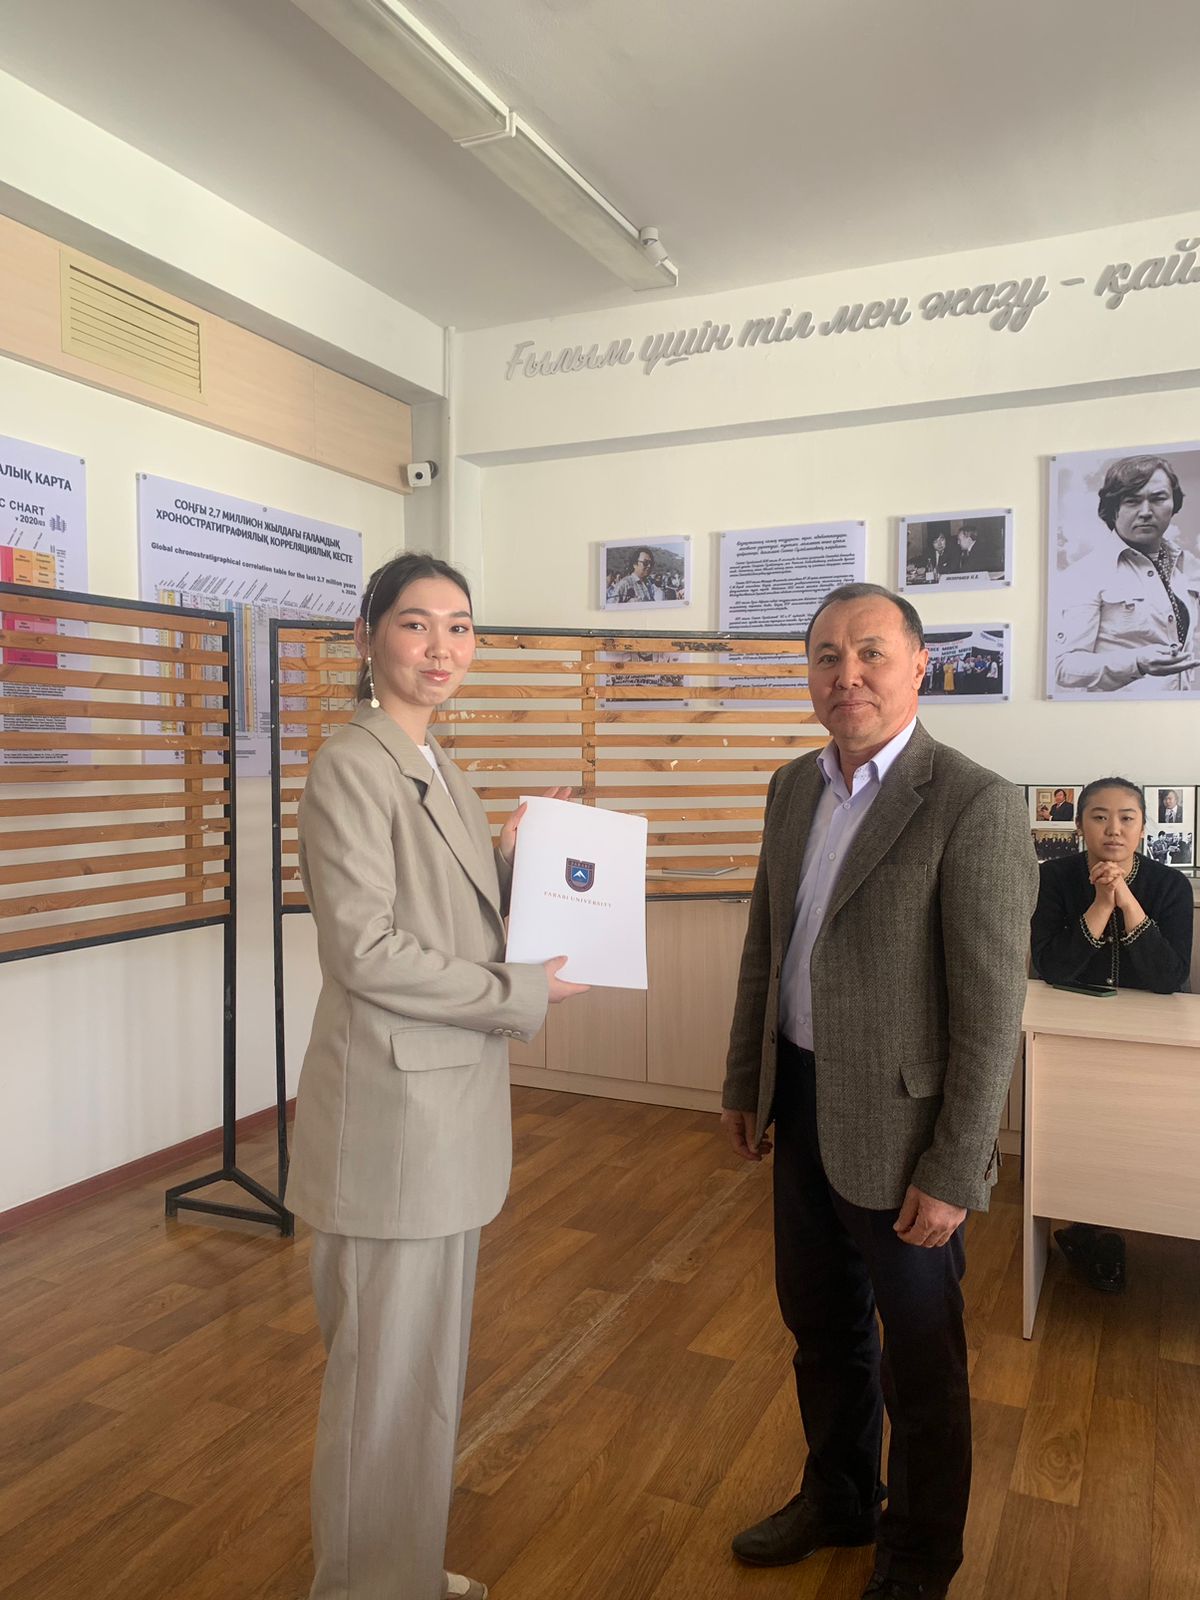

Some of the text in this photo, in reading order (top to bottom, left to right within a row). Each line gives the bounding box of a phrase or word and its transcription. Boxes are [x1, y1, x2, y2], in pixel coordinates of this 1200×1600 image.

[737, 308, 815, 348] тіл
[819, 297, 911, 336] мен
[918, 276, 1049, 332] жазу
[1093, 237, 1200, 310] қай
[35, 472, 72, 491] КАРТА
[9, 500, 45, 516] CHART
[174, 499, 207, 515] СОҢҒЫ
[208, 506, 221, 518] 2,7
[222, 510, 263, 529] МИЛЛИОН
[264, 521, 302, 540] ЖЫЛДАҒЫ
[156, 508, 353, 563] ХРОНОСТРАТИГРАФИЯЛЫҚ КОРРЕЛЯЦИЯЛЫҚ КЕСТЕ
[151, 541, 174, 552] Global
[174, 547, 241, 567] chronostratigraphical
[241, 560, 273, 573] correlation
[273, 567, 287, 576] table
[296, 571, 305, 579] the
[305, 573, 316, 581] last
[570, 895, 612, 908] UNIVERSITY
